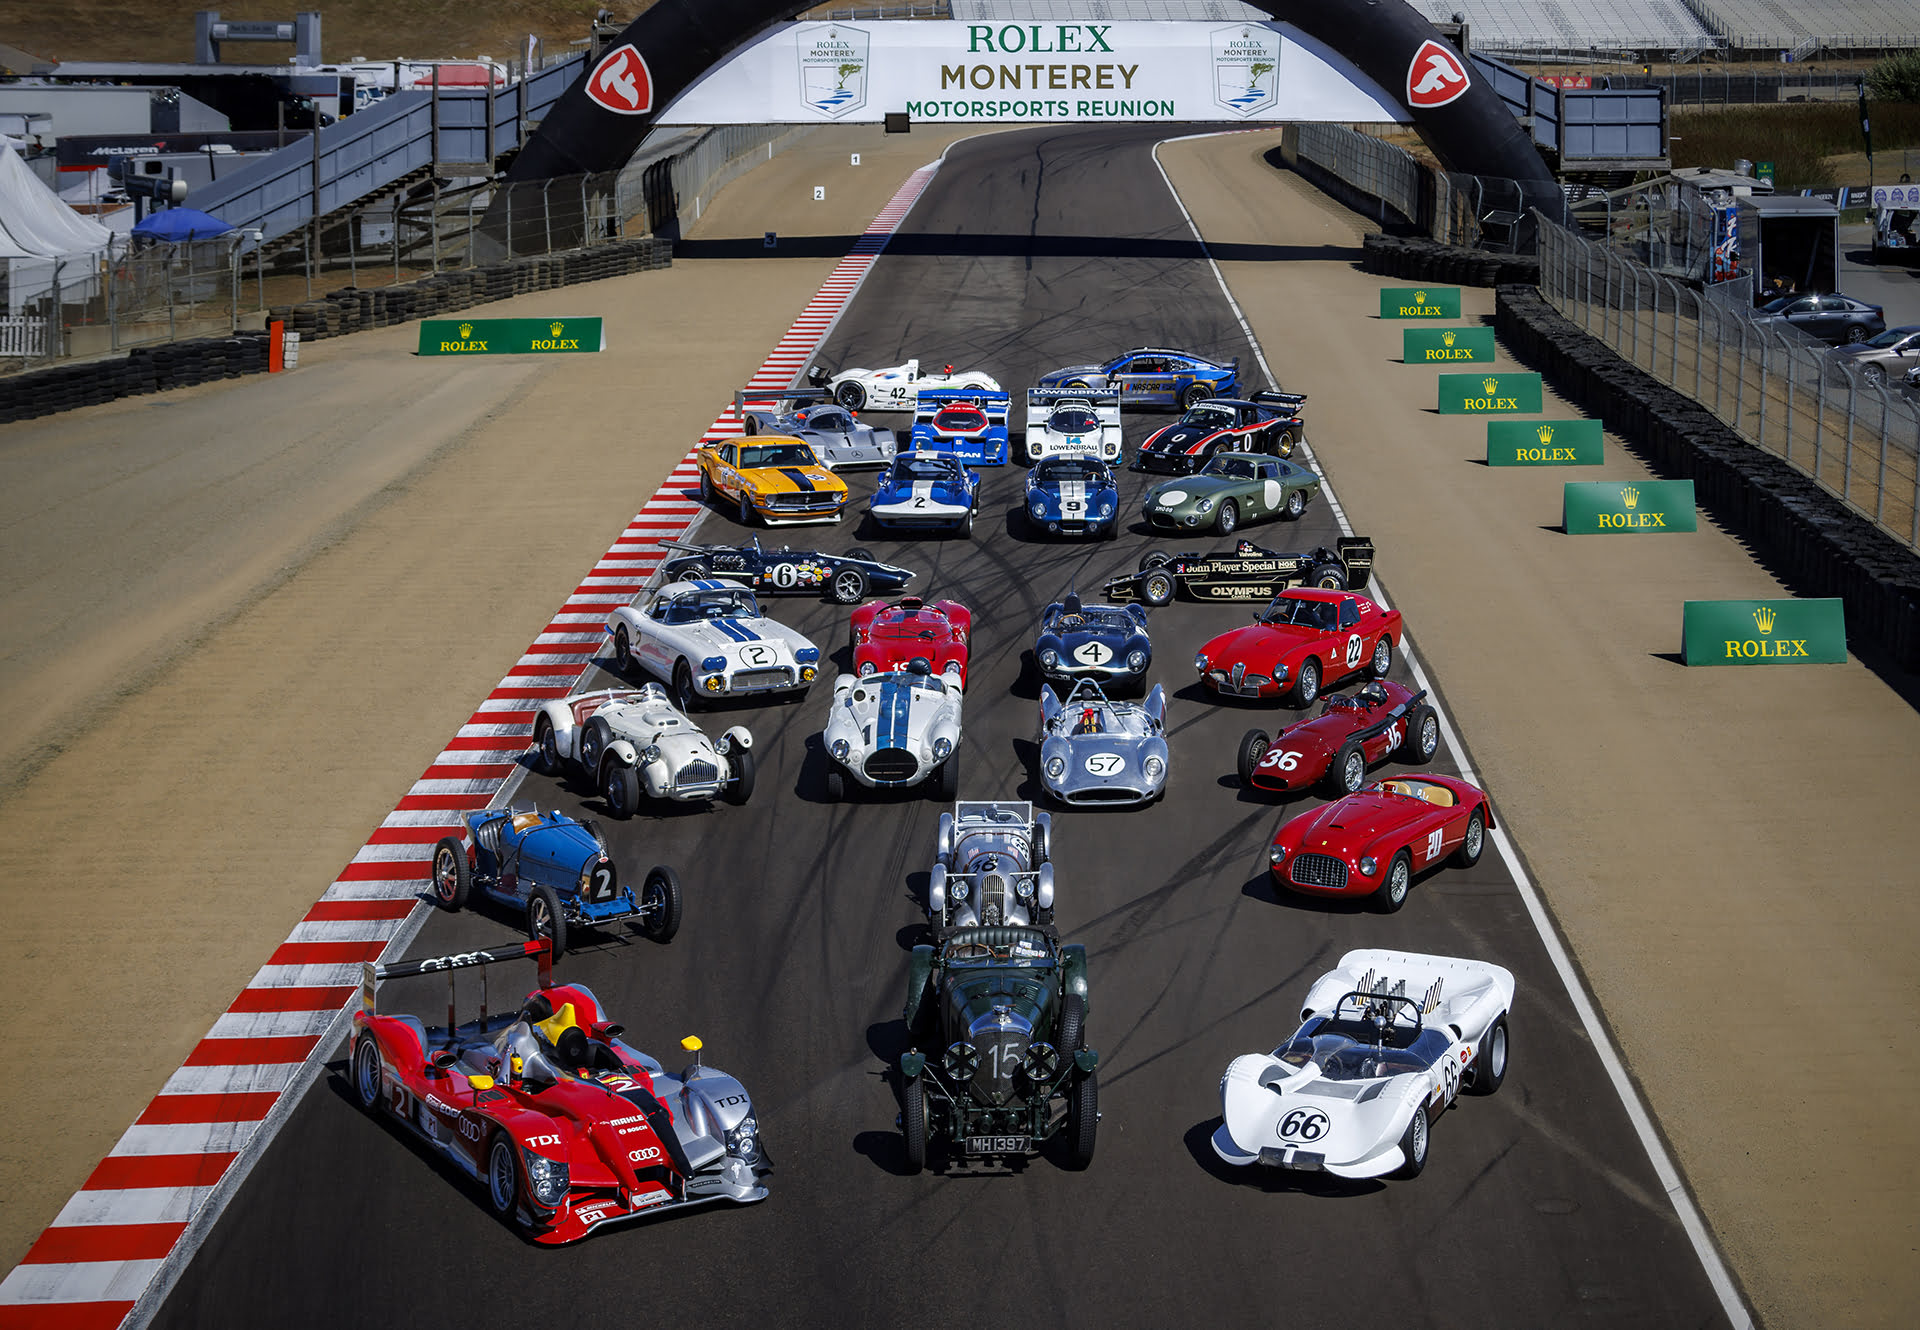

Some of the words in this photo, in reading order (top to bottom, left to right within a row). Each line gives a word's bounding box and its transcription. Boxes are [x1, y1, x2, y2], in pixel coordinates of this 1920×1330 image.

[816, 41, 849, 49] ROLEX
[967, 24, 1114, 53] ROLEX
[1229, 40, 1262, 48] ROLEX
[941, 64, 1139, 90] MONTEREY
[906, 100, 1070, 117] MOTORSPORTS
[1077, 100, 1175, 117] REUNION
[91, 146, 159, 155] McLaren
[816, 190, 822, 199] 2
[766, 234, 774, 245] 3
[1399, 306, 1442, 316] ROLEX
[440, 340, 488, 352] ROLEX
[531, 339, 580, 350] ROLEX
[1425, 348, 1474, 360] ROLEX
[890, 387, 906, 399] 42
[1131, 383, 1161, 391] NASCAR
[1464, 398, 1518, 410] ROLEX
[1066, 436, 1082, 444] 14
[1171, 433, 1187, 443] 0
[1244, 433, 1252, 452] 0
[1516, 447, 1577, 461] ROLEX
[913, 497, 926, 508] 2
[1066, 500, 1081, 512] 9
[1597, 512, 1667, 528] ROLEX
[1186, 563, 1210, 573] John
[1211, 562, 1241, 575] Player
[1242, 560, 1276, 573] Special
[777, 564, 791, 586] 6
[1210, 586, 1272, 596] OLYMPUS
[1082, 643, 1102, 663] 4
[1346, 636, 1361, 664] 22
[1724, 639, 1809, 658] ROLEX
[749, 647, 769, 665] 2
[862, 725, 870, 746] 1
[1383, 721, 1402, 754] 36
[1089, 757, 1121, 773] 57
[1259, 749, 1304, 771] 36
[1425, 827, 1443, 861] 20
[595, 868, 613, 898] 2
[988, 1043, 1020, 1079] 15
[609, 1080, 641, 1093] 2
[1445, 1060, 1458, 1104] 66
[714, 1094, 748, 1109] TDI
[610, 1114, 645, 1127] MAHLE
[1280, 1110, 1328, 1140] 66
[627, 1125, 648, 1133] BOSCH
[525, 1134, 562, 1148] TDI
[584, 1212, 602, 1222] P1
